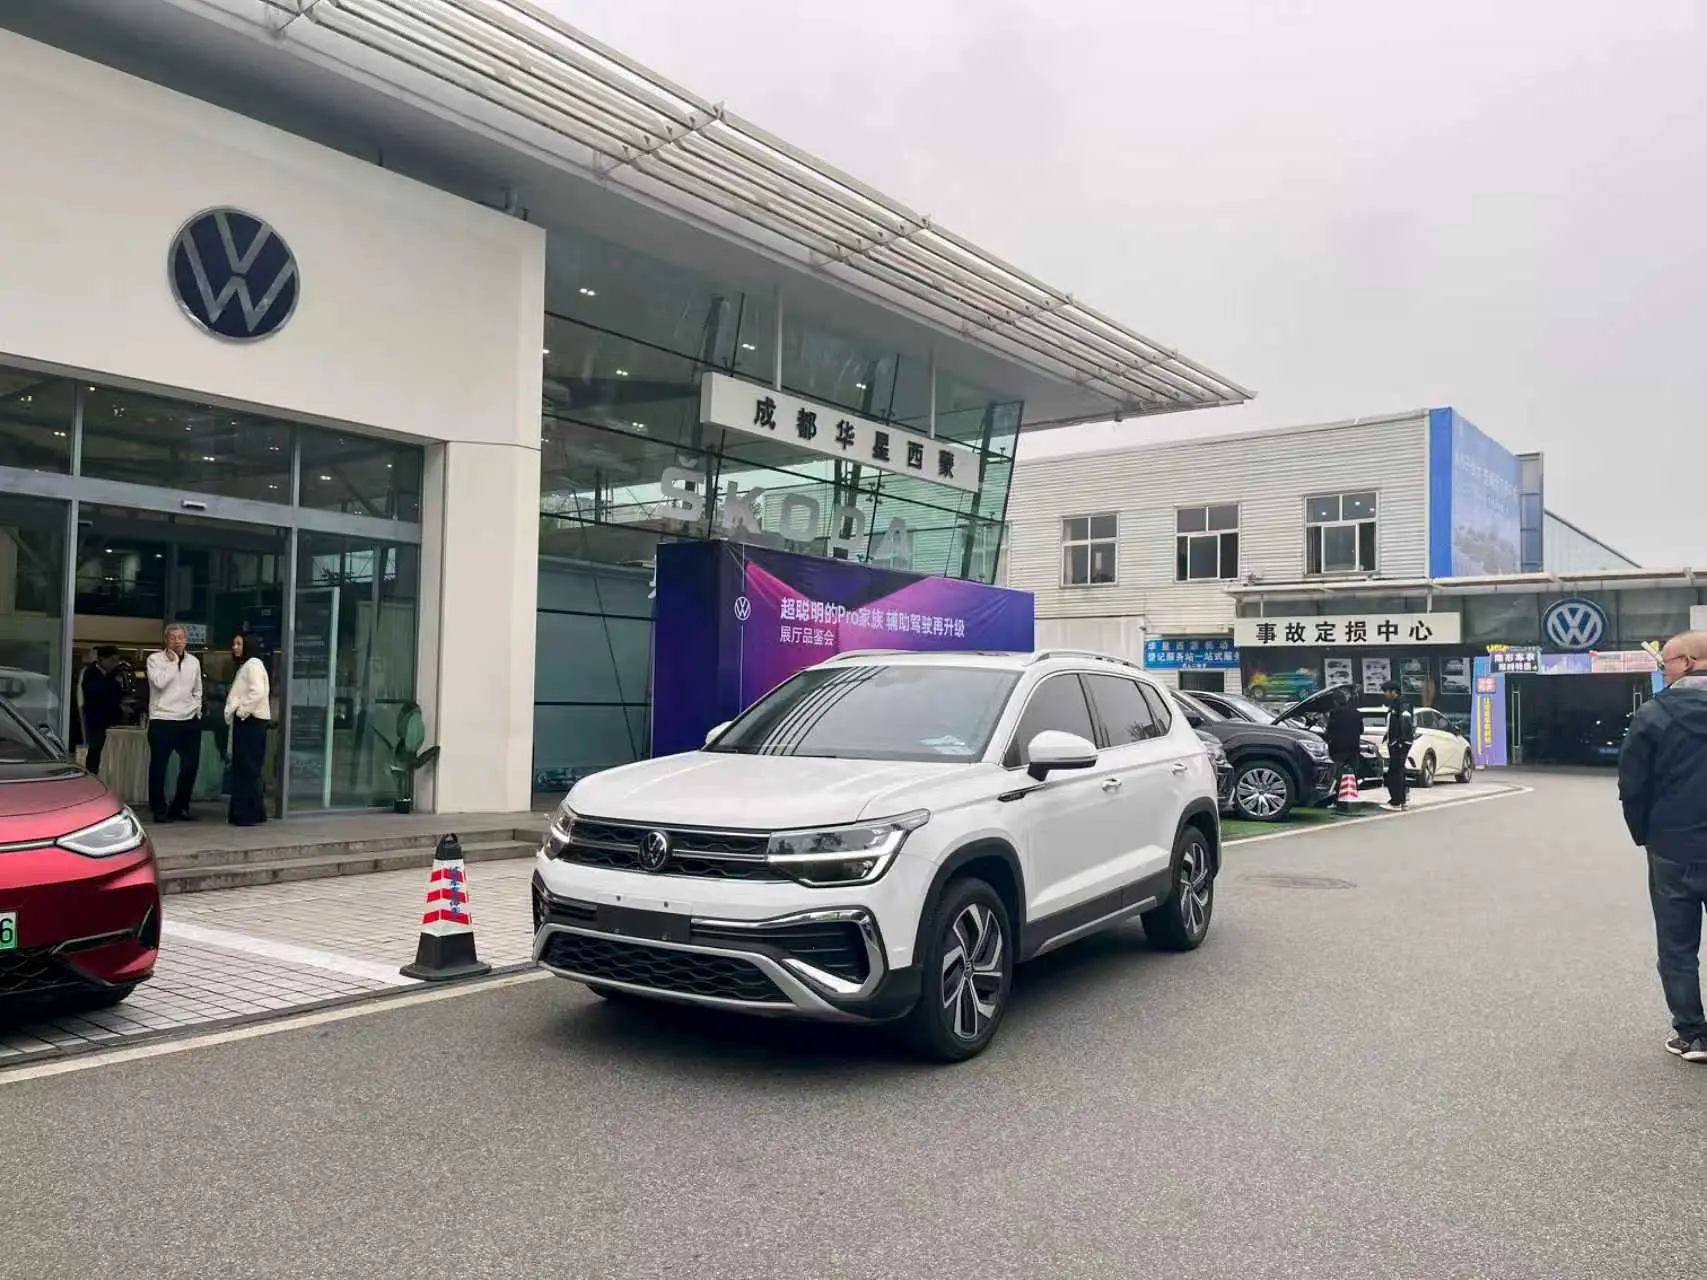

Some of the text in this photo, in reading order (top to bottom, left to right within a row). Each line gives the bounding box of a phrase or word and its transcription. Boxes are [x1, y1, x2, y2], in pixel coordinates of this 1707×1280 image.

[780, 597, 965, 638] 超聪明的Pro家族 辅助驾驶再升级
[780, 625, 836, 646] 展厅品鉴会
[1256, 619, 1433, 644] 事故定损中心
